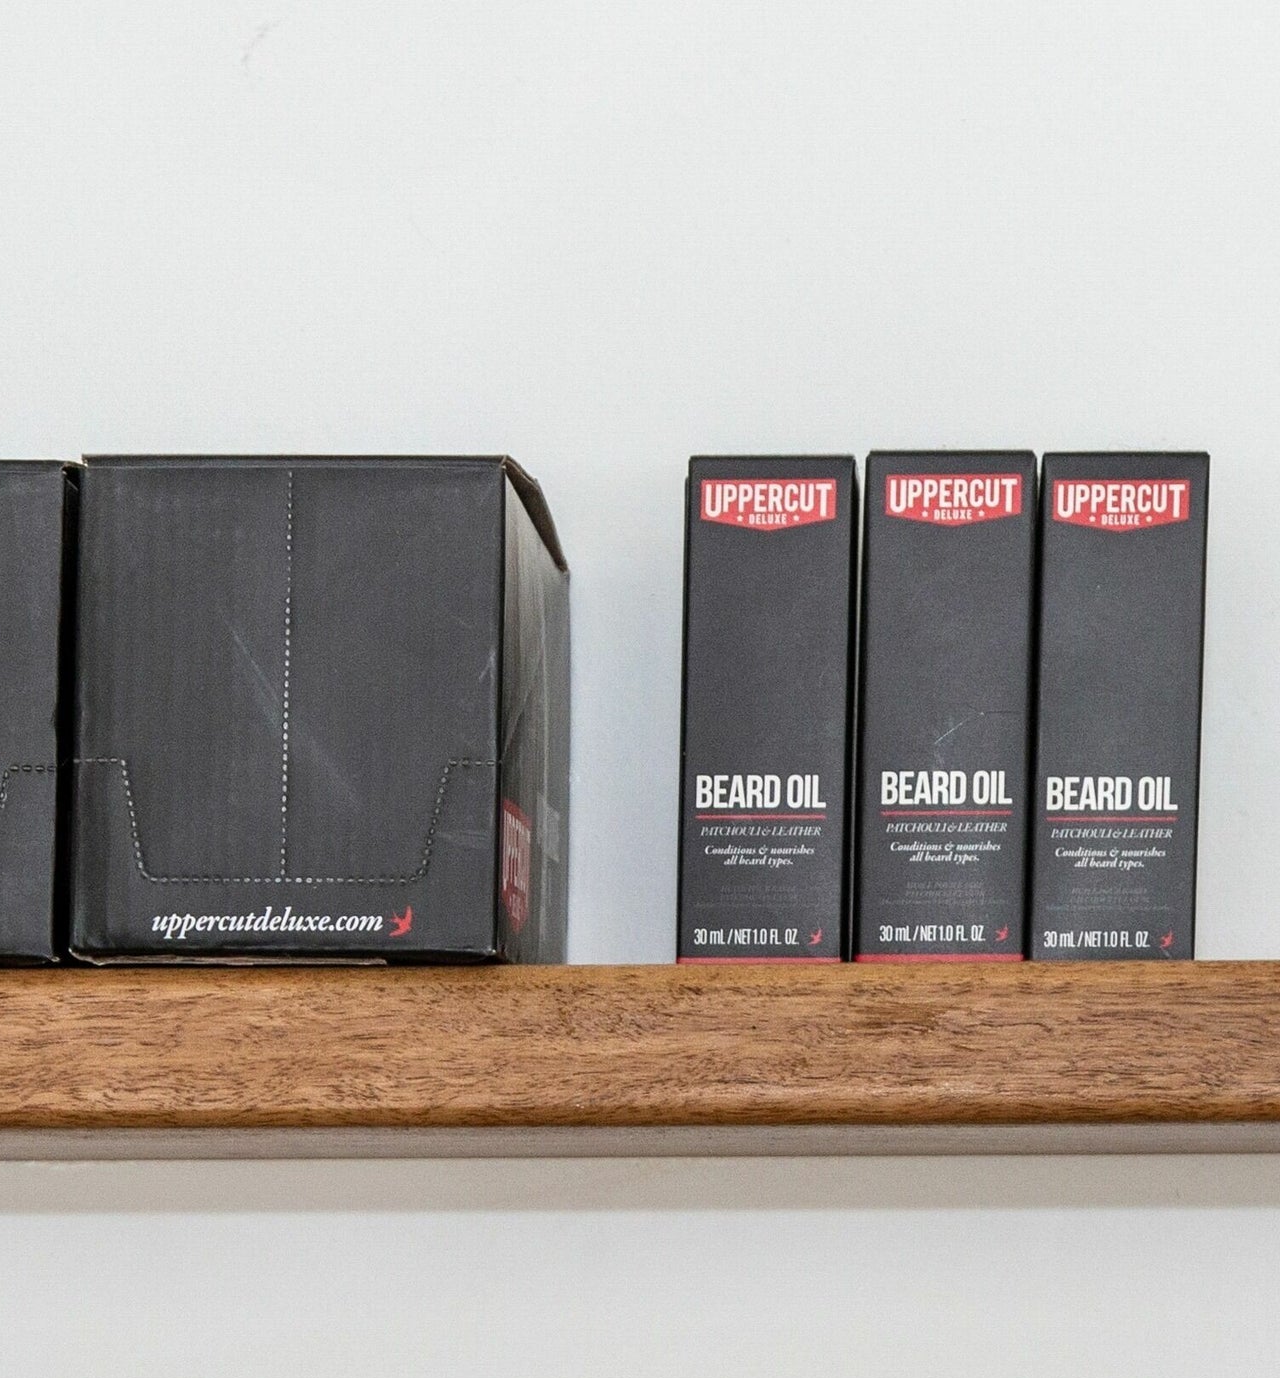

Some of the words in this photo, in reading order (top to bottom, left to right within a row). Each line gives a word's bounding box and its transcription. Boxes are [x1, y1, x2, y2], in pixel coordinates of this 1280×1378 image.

[705, 484, 832, 519] UPPERCUT
[890, 478, 1018, 514] UPPERCUT
[1057, 484, 1186, 520] UPPERCUT
[748, 515, 788, 525] DELUXE
[933, 509, 973, 521] DELUXE
[1101, 515, 1140, 526] DELUXE
[696, 775, 782, 811] BEARD
[788, 775, 826, 809] OIL
[881, 771, 966, 806] BEARD
[973, 771, 1012, 805] OIL
[1046, 778, 1133, 813] BEARD
[1138, 776, 1178, 812] OIL
[890, 842, 942, 851] Conditions
[945, 842, 955, 851] &
[957, 841, 1001, 851] nourishes
[910, 852, 923, 862] all
[925, 852, 952, 862] beard
[953, 853, 979, 864] types.
[151, 907, 384, 940] uppercutdeluxe.com
